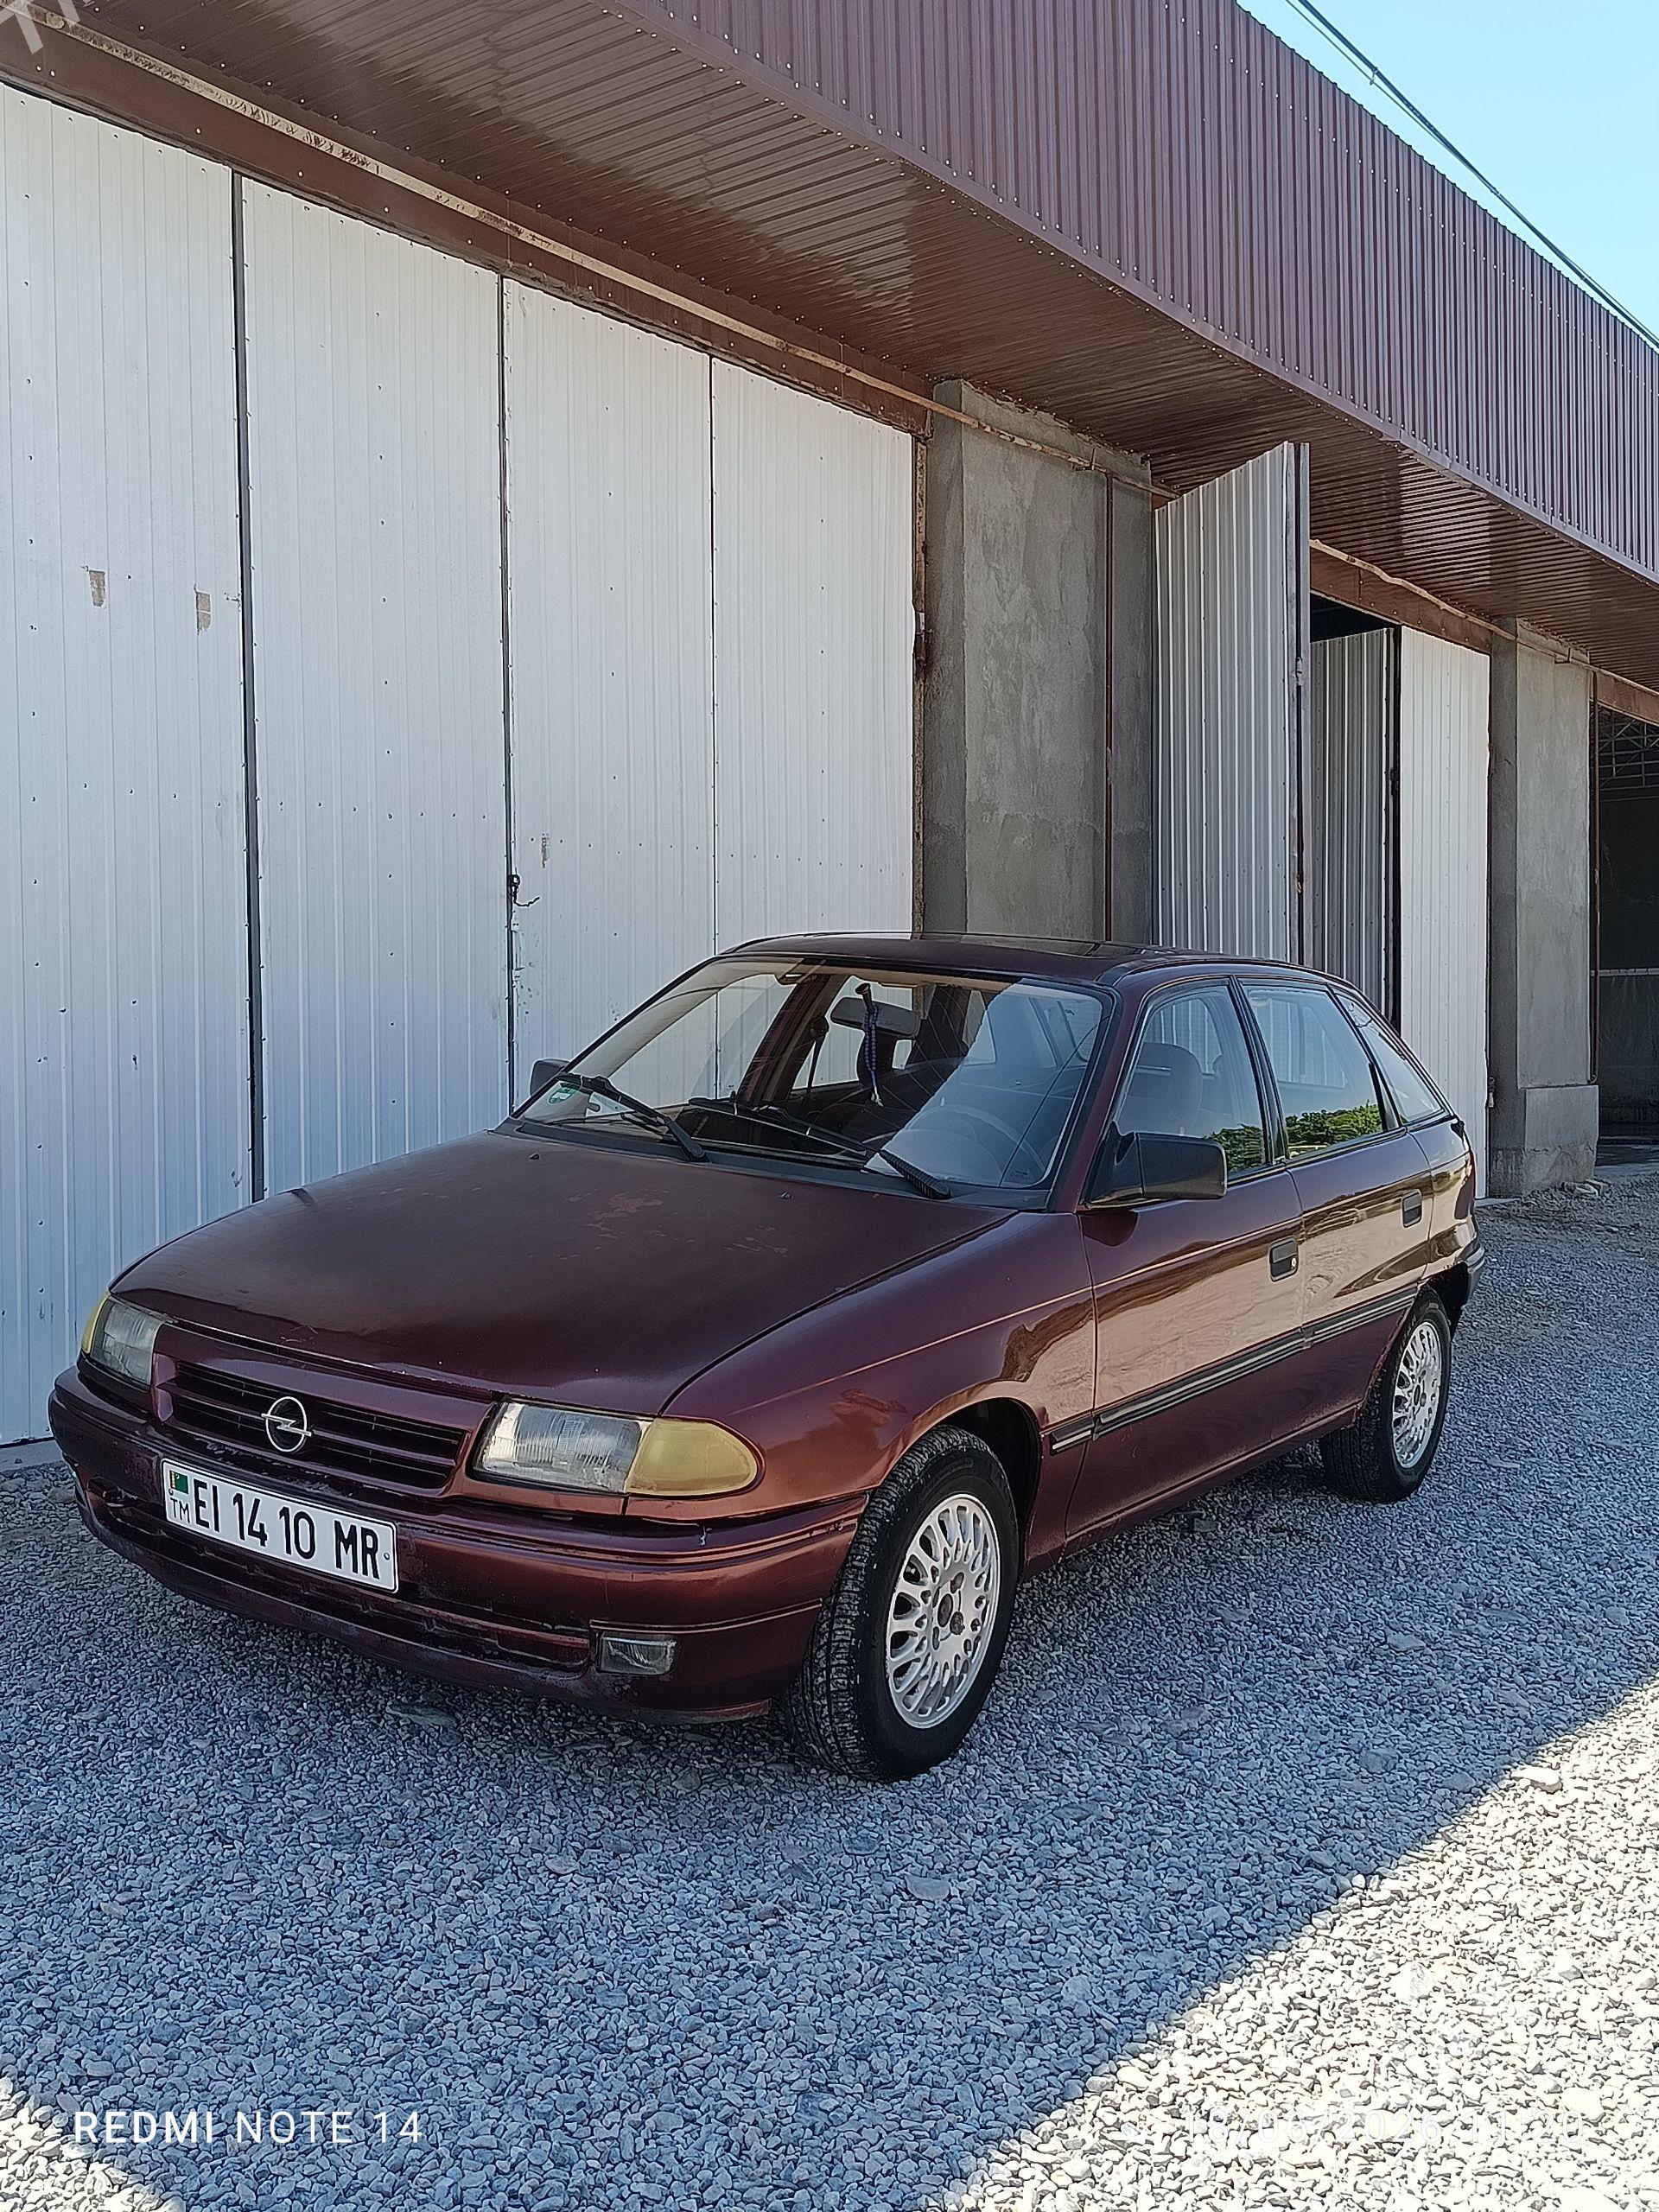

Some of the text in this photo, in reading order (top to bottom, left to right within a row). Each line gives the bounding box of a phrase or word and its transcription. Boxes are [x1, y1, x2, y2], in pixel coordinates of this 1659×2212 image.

[170, 1497, 190, 1523] TM
[194, 1478, 380, 1580] EI 14 10 MR
